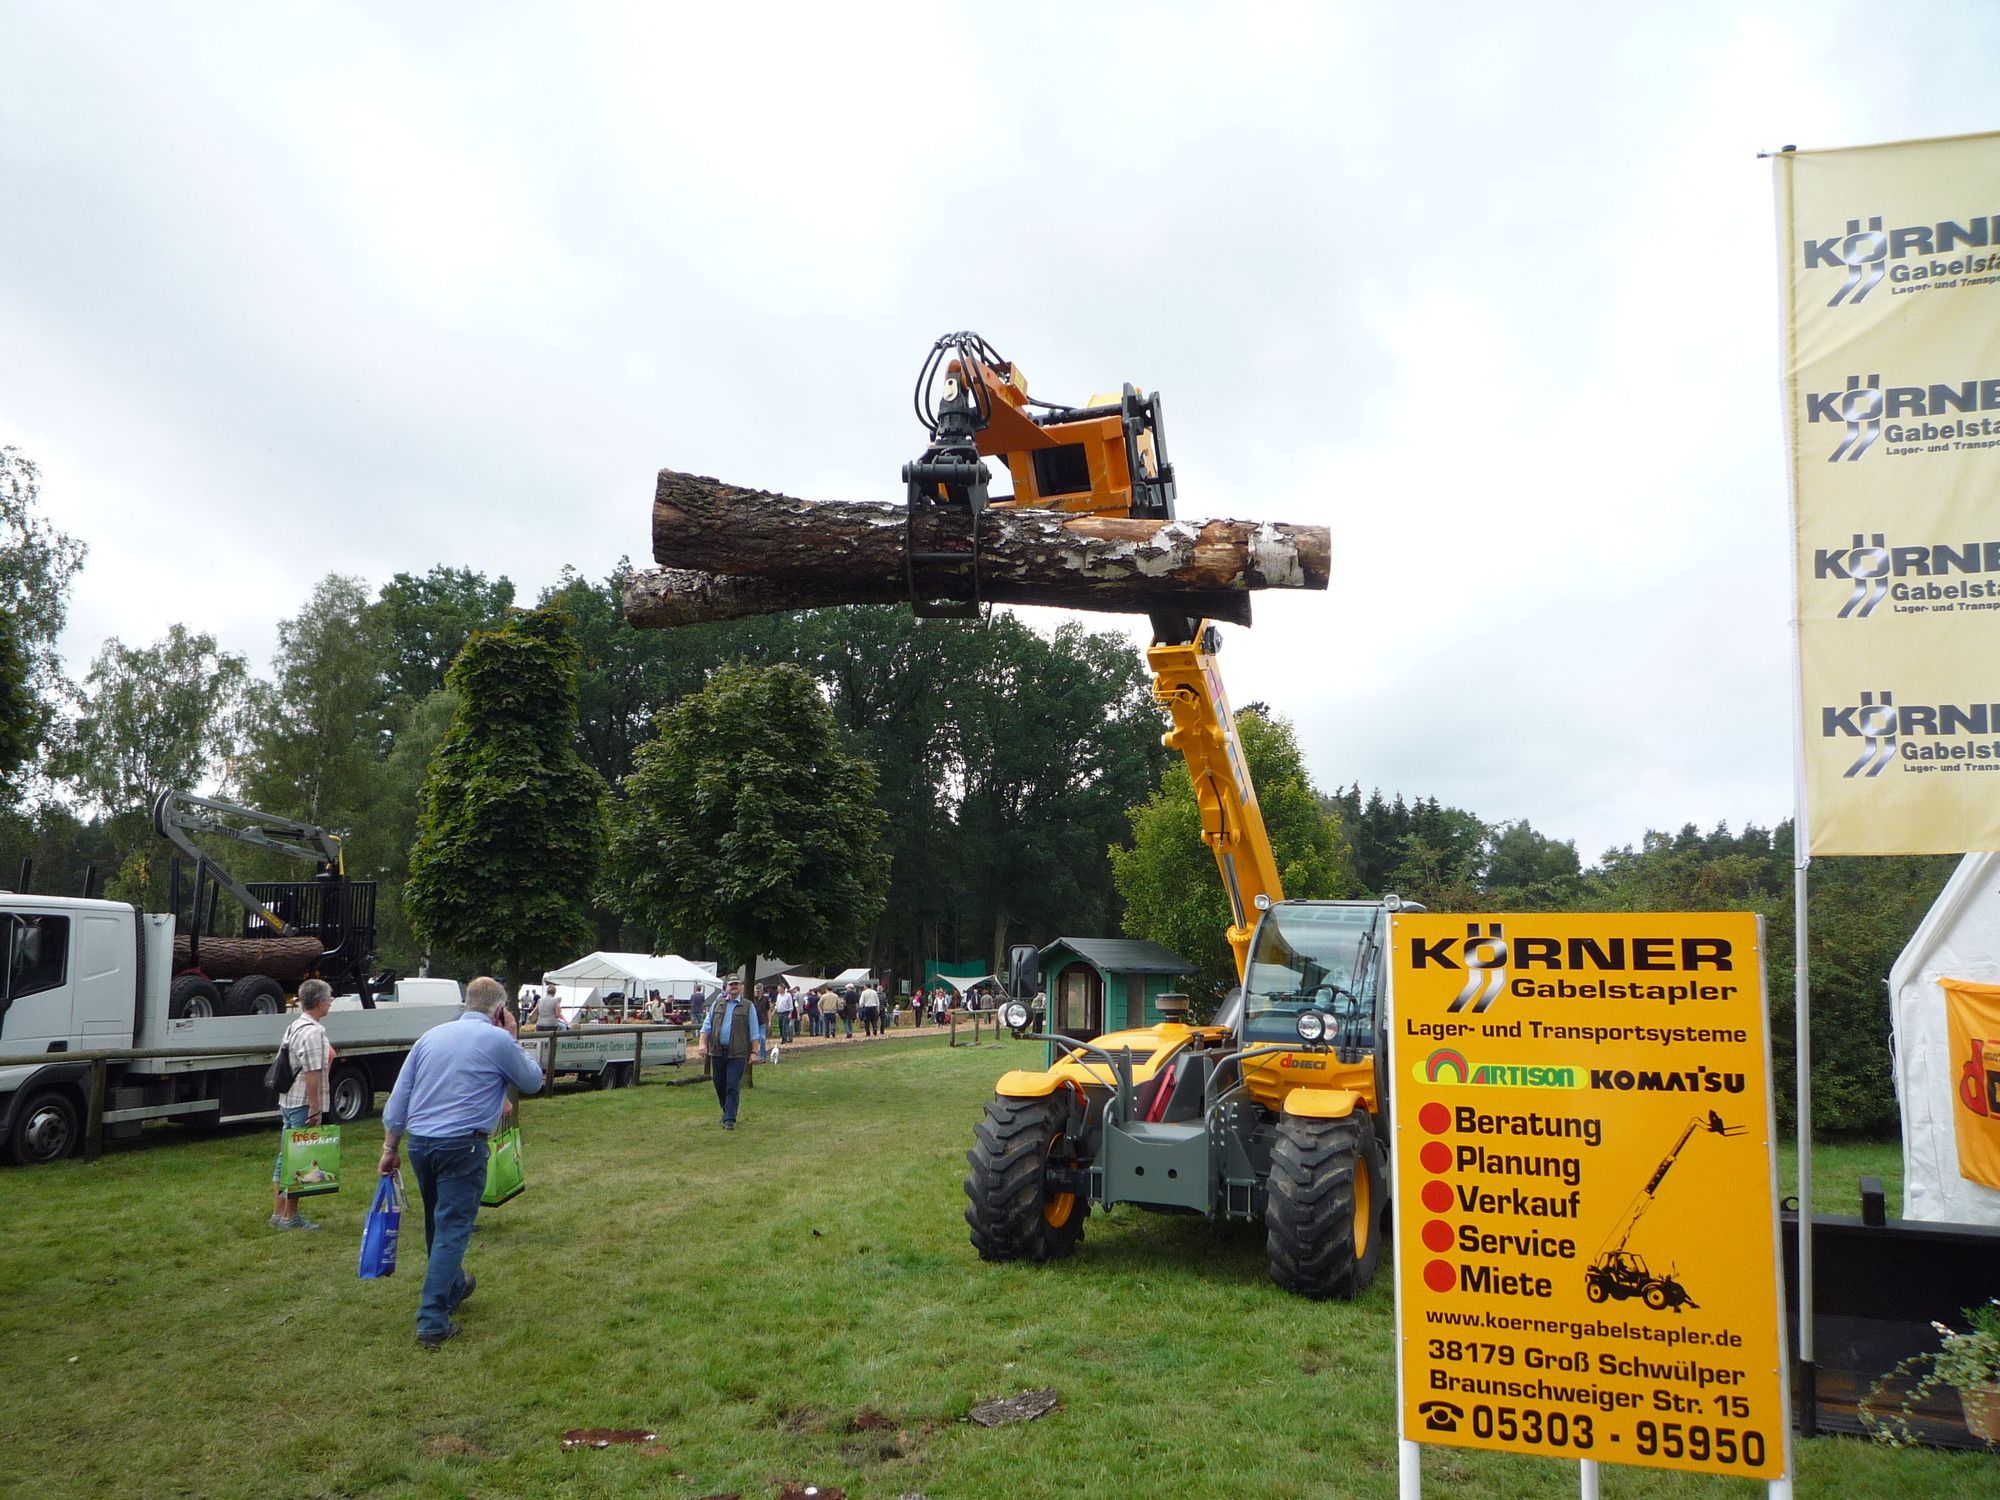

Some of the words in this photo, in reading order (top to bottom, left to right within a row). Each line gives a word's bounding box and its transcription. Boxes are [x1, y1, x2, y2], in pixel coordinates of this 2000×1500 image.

[1892, 283, 1931, 295] Lager-
[1935, 280, 1957, 289] und
[1886, 447, 1923, 456] Lager-
[1927, 443, 1949, 452] und
[1891, 579, 2000, 601] Gabelst
[1894, 604, 1928, 613] Lager-
[1932, 603, 1954, 612] und
[1904, 764, 1937, 773] Lager-
[1941, 763, 1960, 771] und
[1411, 923, 1733, 971] KÖRNER
[1511, 978, 1738, 1004] Gabelstapler
[561, 1040, 595, 1049] KRÜGER
[1406, 1019, 1475, 1041] Lager-
[1482, 1021, 1521, 1038] und
[1529, 1021, 1747, 1046] Transportsysteme
[1591, 1066, 1745, 1093] KOMATSU
[293, 1132, 318, 1142] free
[1455, 1106, 1601, 1146] Beratung
[1456, 1145, 1581, 1186] Planung
[1457, 1184, 1581, 1218] Verkauf
[1458, 1224, 1576, 1259] Service
[1460, 1264, 1553, 1298] Miete
[1426, 1310, 1742, 1347] www.koernergabelstapler.de
[1428, 1339, 1515, 1366] 38179
[1524, 1347, 1590, 1373] Groß
[1599, 1353, 1746, 1389] Schwülper
[1430, 1368, 1644, 1412] Braunschweiger
[1653, 1390, 1703, 1414] Str.
[1713, 1395, 1750, 1418] 15
[1472, 1404, 1594, 1449] 05303
[1636, 1420, 1766, 1467] 95950
